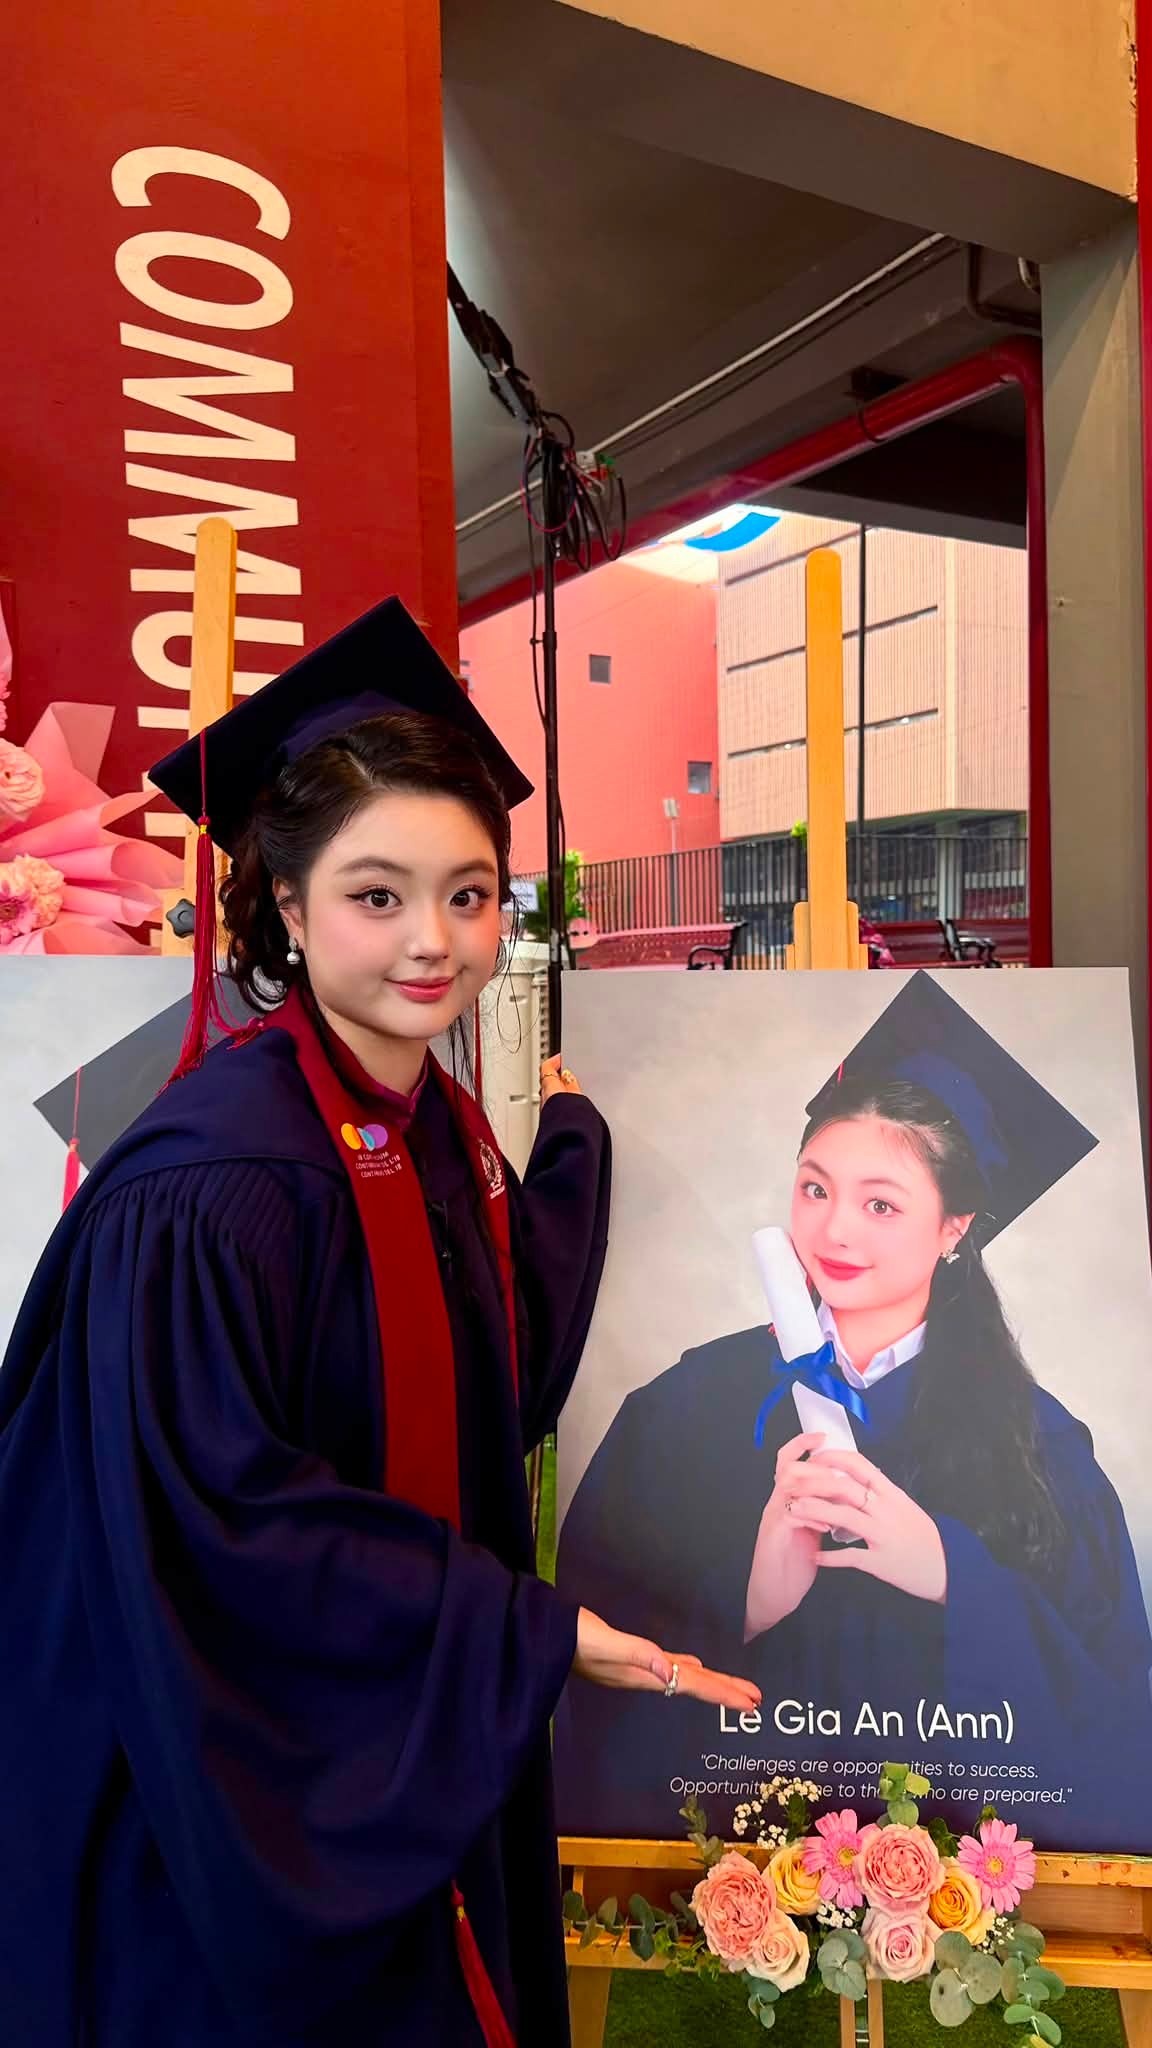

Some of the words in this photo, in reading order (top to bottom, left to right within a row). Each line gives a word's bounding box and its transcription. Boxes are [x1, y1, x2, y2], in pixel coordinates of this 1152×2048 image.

[111, 146, 305, 837] COMMU
[773, 1699, 841, 1736] Gia
[853, 1702, 904, 1737] An
[916, 1698, 1014, 1744] (Ann)
[700, 1754, 796, 1775] "Challenges
[800, 1760, 829, 1773] are
[832, 1760, 943, 1777] opporities
[948, 1761, 965, 1776] to
[970, 1764, 1039, 1779] success.
[669, 1776, 764, 1797] Opportunit
[838, 1783, 856, 1798] to
[951, 1787, 980, 1801] are
[983, 1787, 1073, 1805] prepared."
